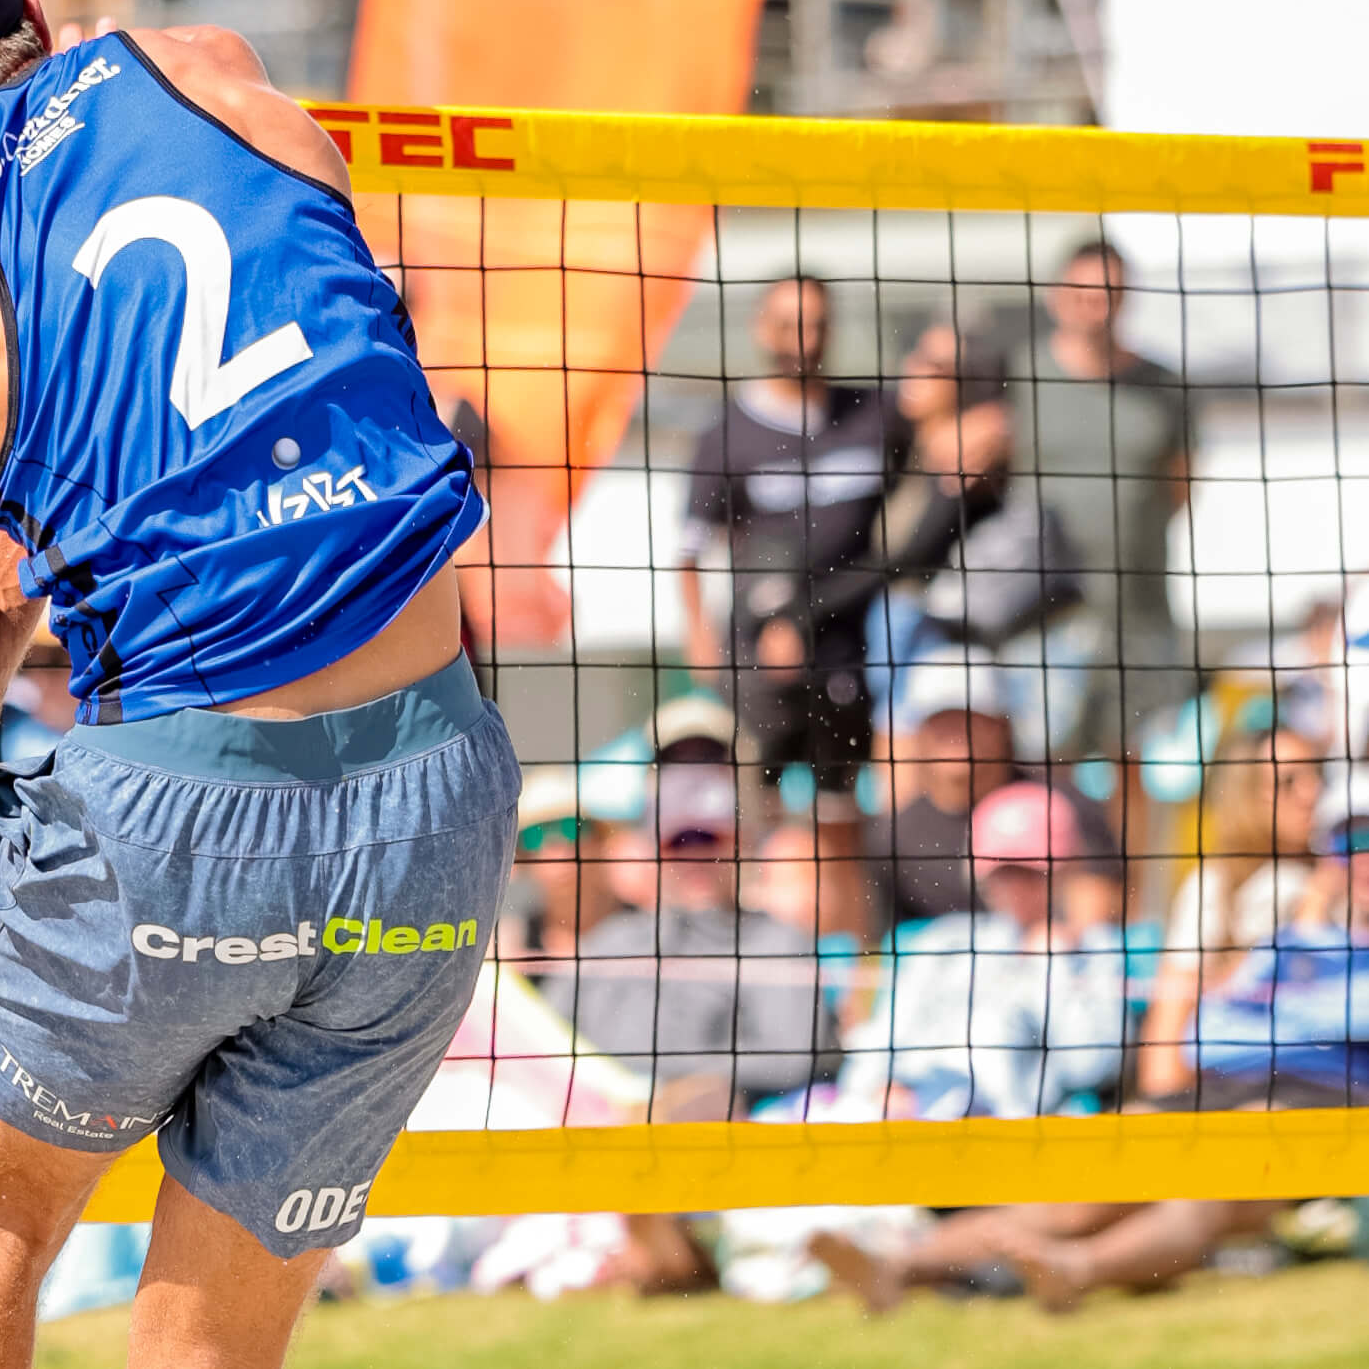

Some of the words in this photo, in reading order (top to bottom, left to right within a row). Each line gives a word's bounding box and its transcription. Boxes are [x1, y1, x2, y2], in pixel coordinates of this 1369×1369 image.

[306, 109, 515, 172] TEC
[71, 195, 315, 432] 2
[33, 1110, 64, 1130] Real
[67, 1125, 114, 1140] Estate
[275, 1178, 372, 1233] ODE
